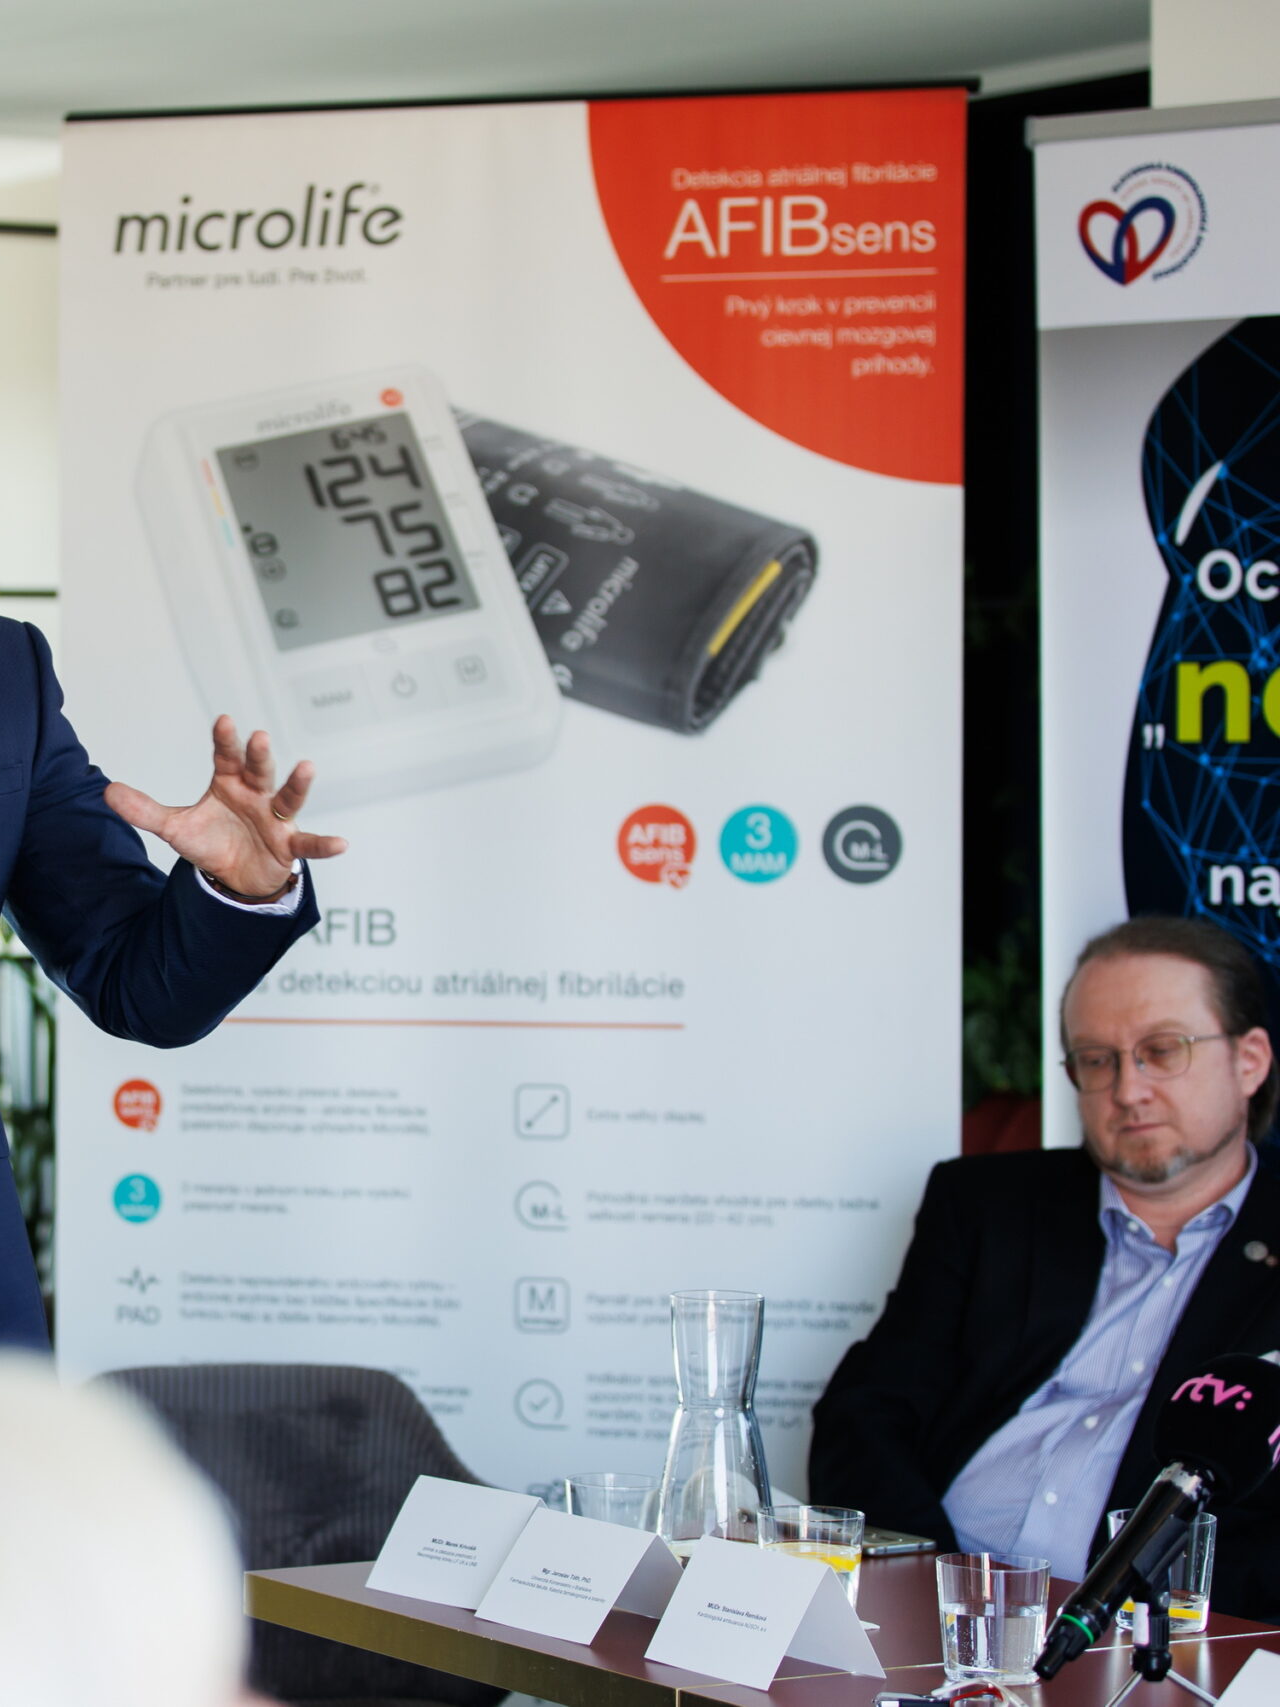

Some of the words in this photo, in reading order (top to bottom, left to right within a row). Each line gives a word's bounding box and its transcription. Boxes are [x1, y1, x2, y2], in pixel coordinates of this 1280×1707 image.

[114, 182, 402, 253] microlife
[304, 443, 421, 509] 124
[342, 503, 444, 557] 75
[374, 557, 462, 618] 82
[745, 812, 773, 850] 3
[279, 970, 423, 995] detekciou
[433, 970, 549, 1000] atriálnej
[558, 970, 686, 999] fibrilácie
